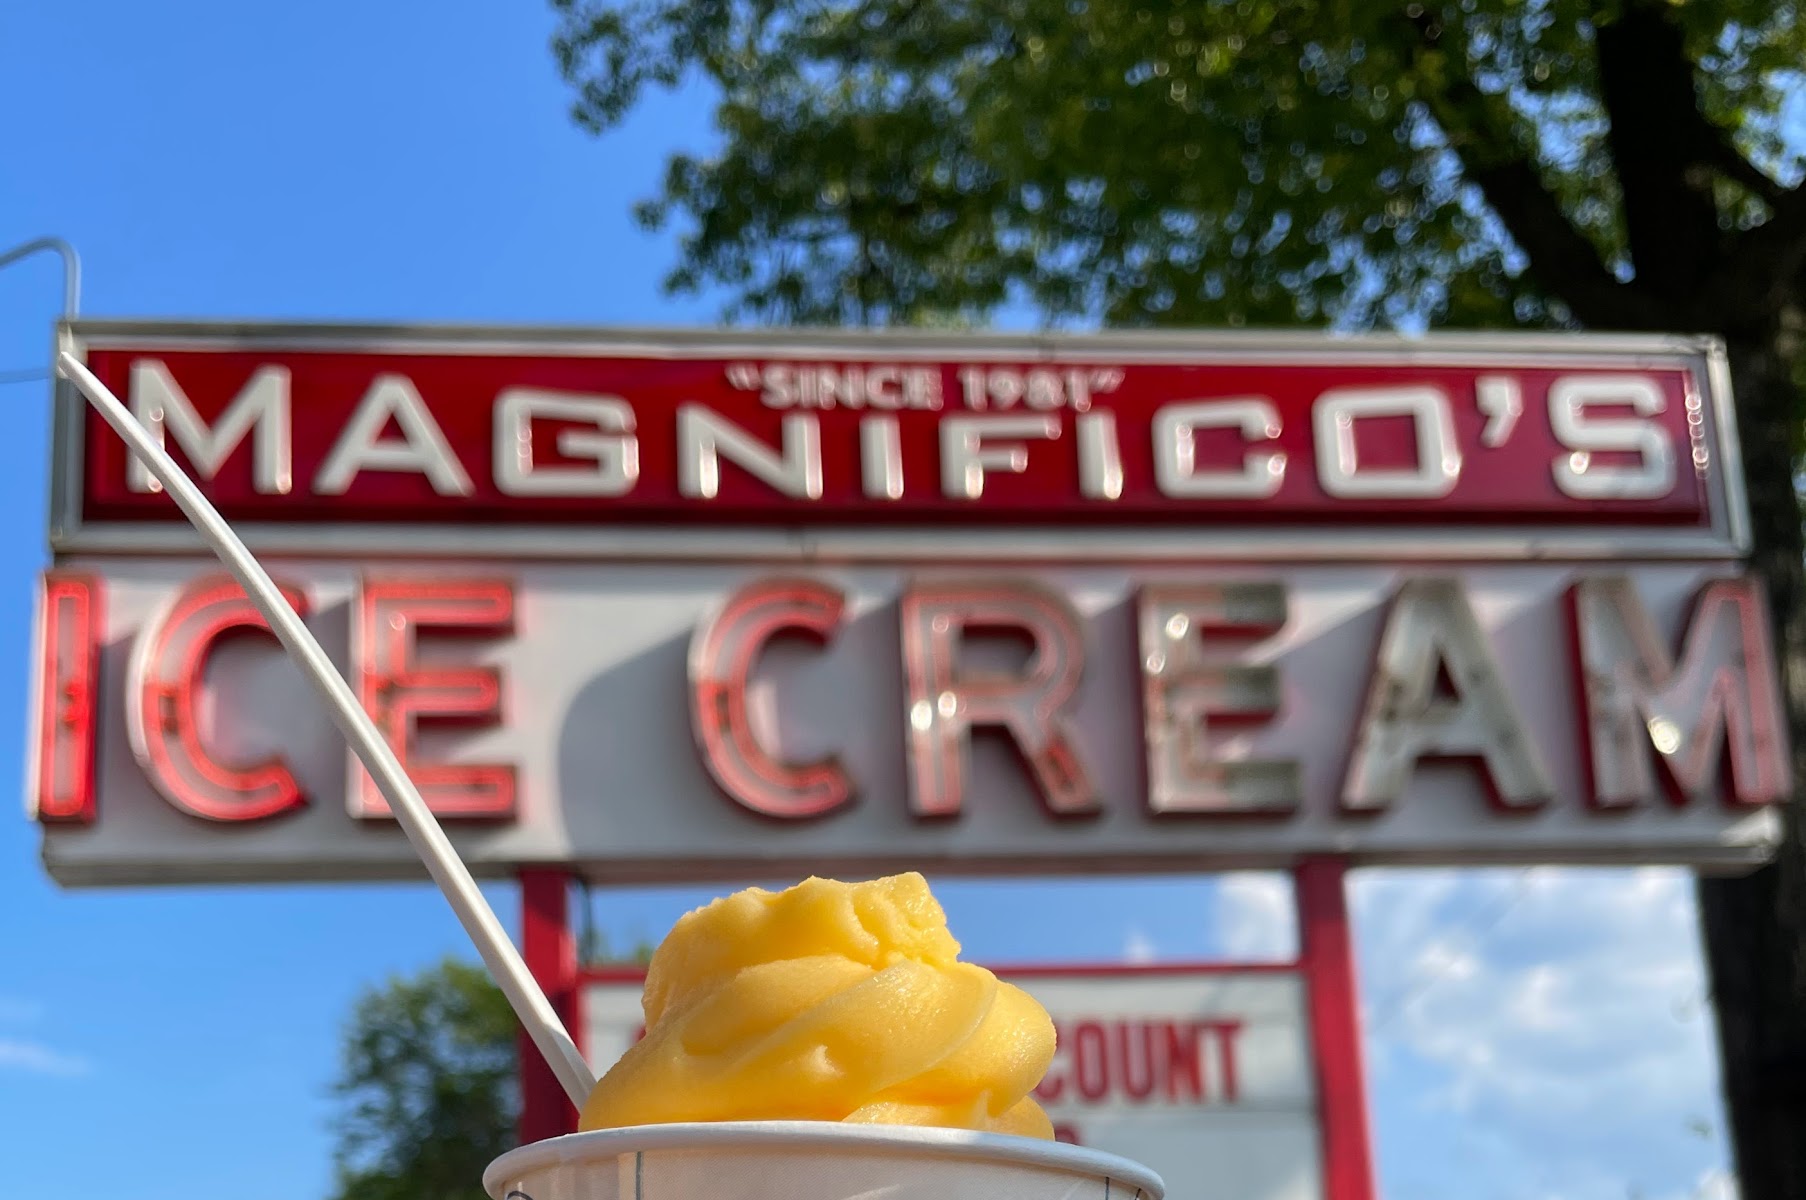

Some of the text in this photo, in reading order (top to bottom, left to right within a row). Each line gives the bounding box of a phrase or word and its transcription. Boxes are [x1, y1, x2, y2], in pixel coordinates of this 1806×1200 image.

[126, 358, 1680, 501] MAGNIFICO'S
[28, 568, 1792, 822] ICE CREAM
